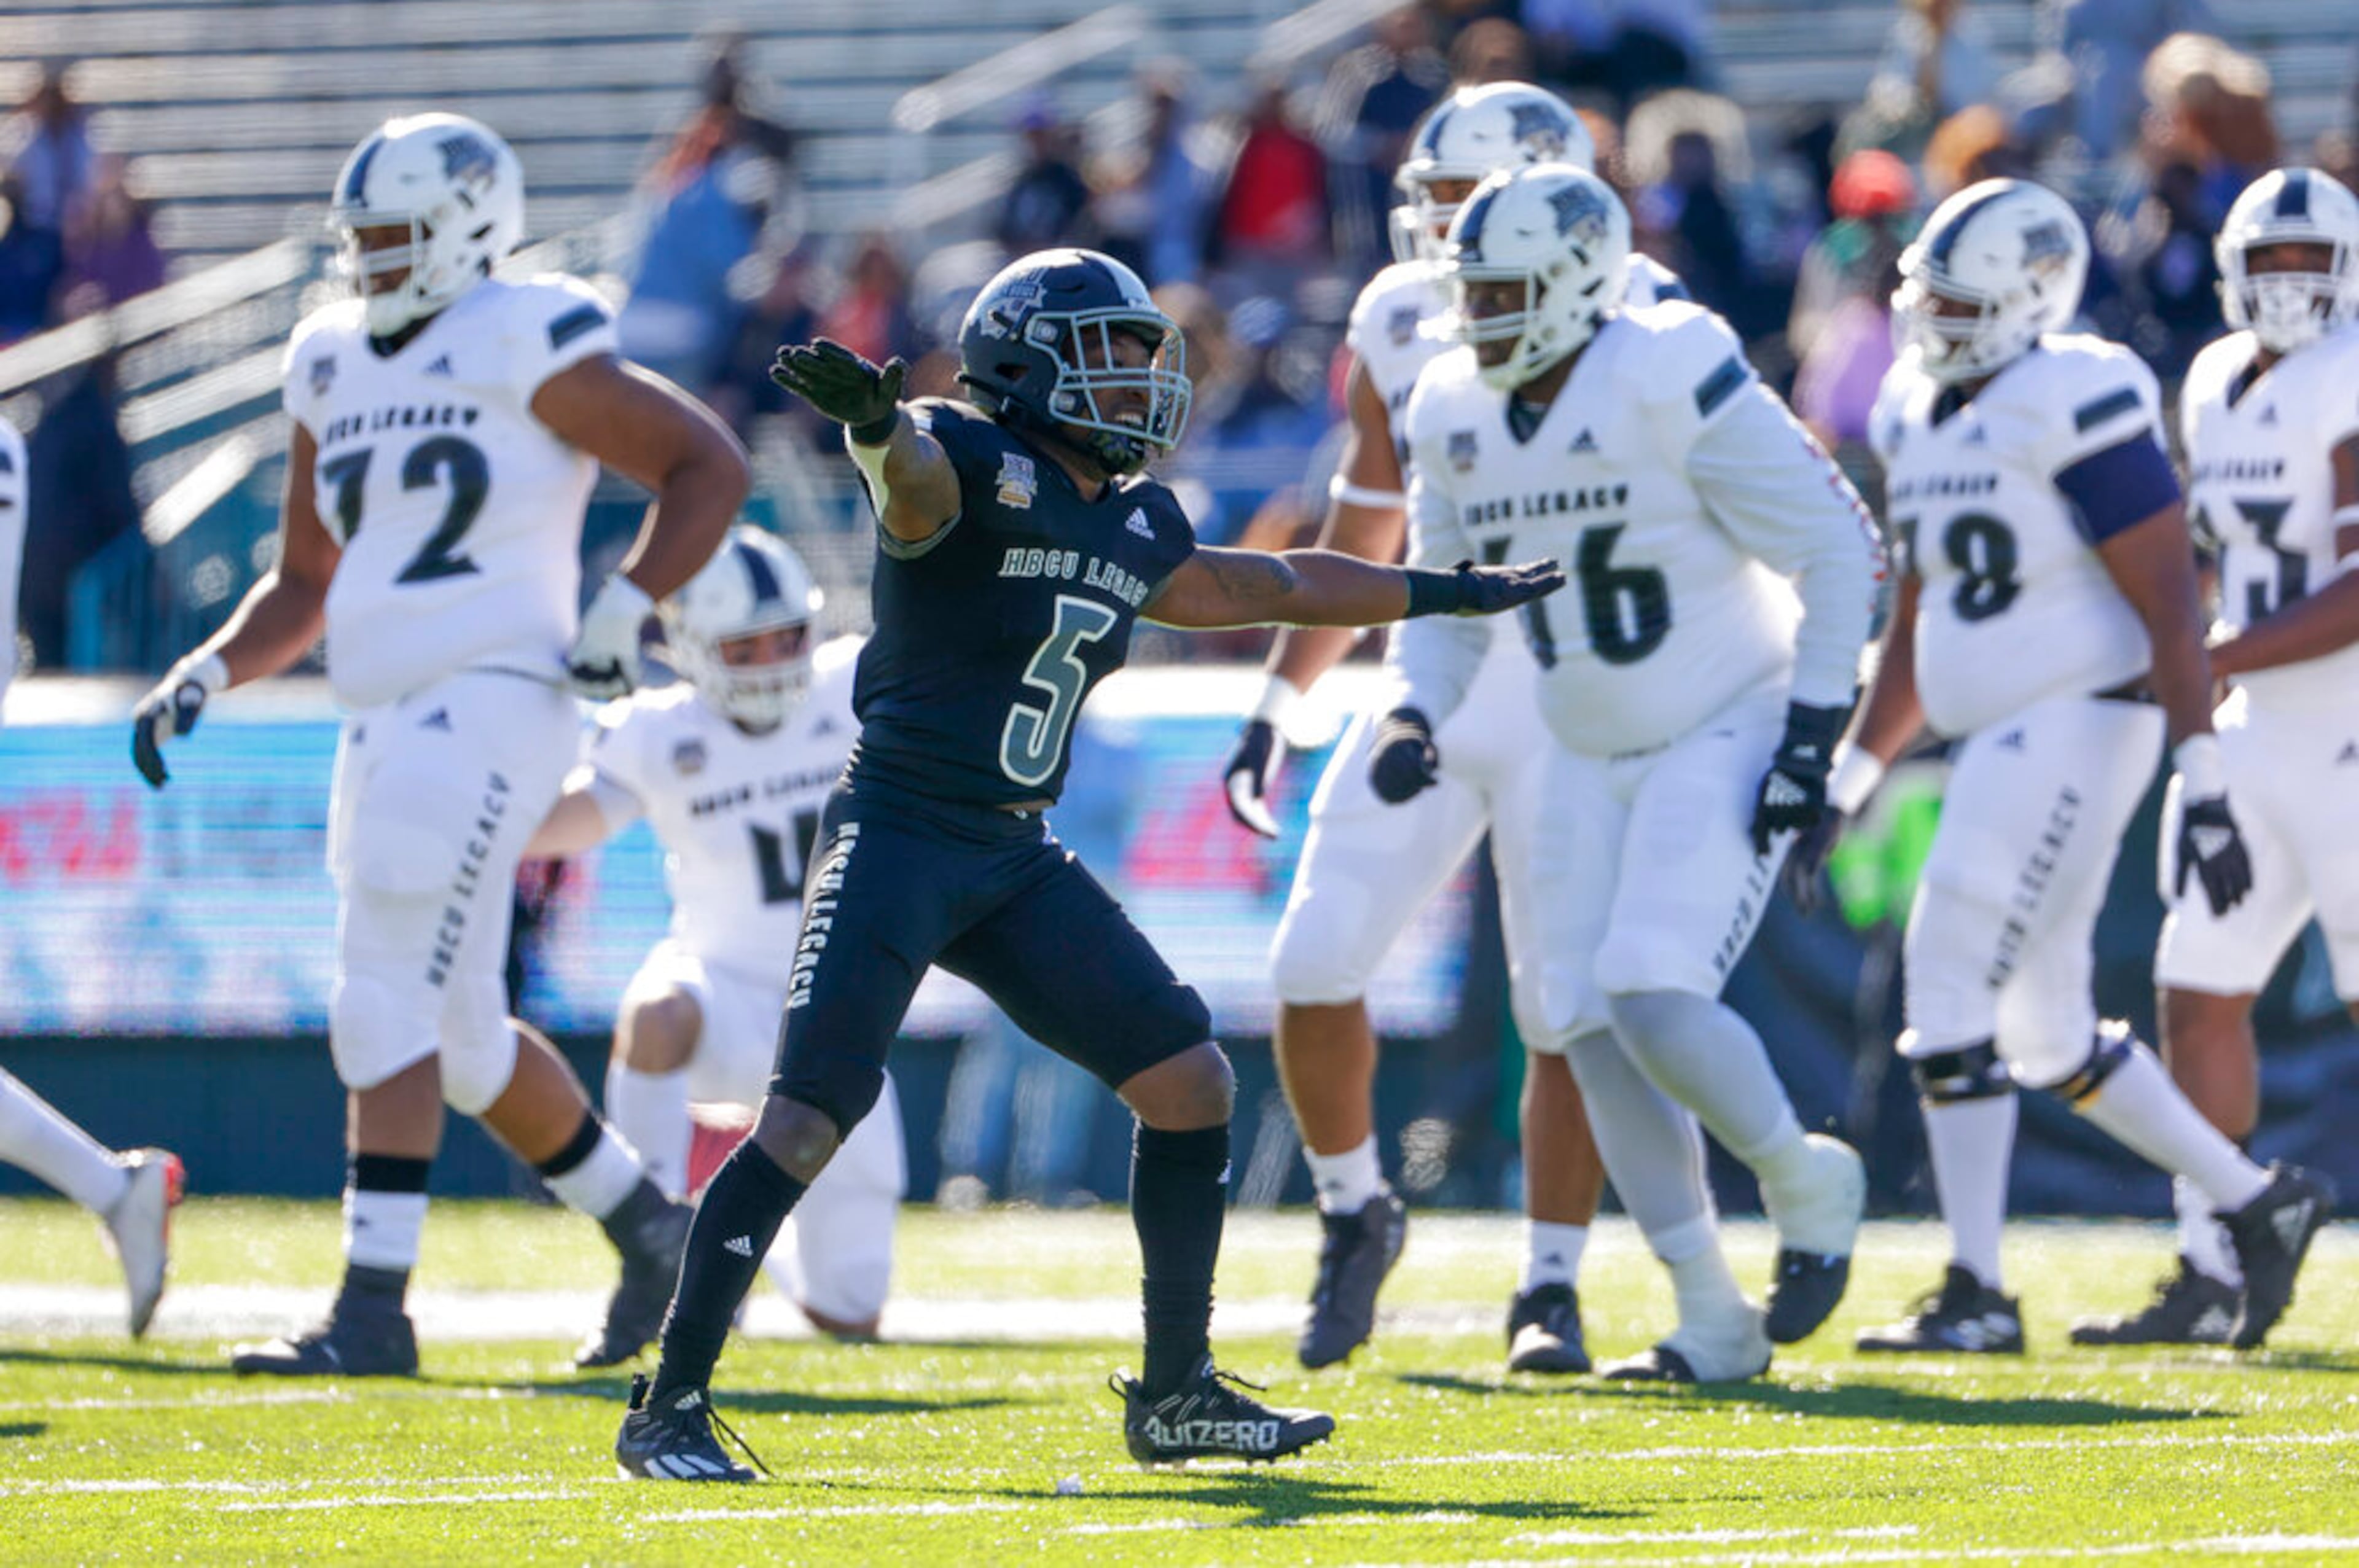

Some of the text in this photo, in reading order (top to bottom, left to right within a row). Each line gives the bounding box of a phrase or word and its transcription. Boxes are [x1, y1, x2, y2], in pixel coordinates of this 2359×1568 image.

[320, 434, 490, 585] 72
[996, 547, 1079, 580] HBCU
[998, 594, 1118, 787] 5
